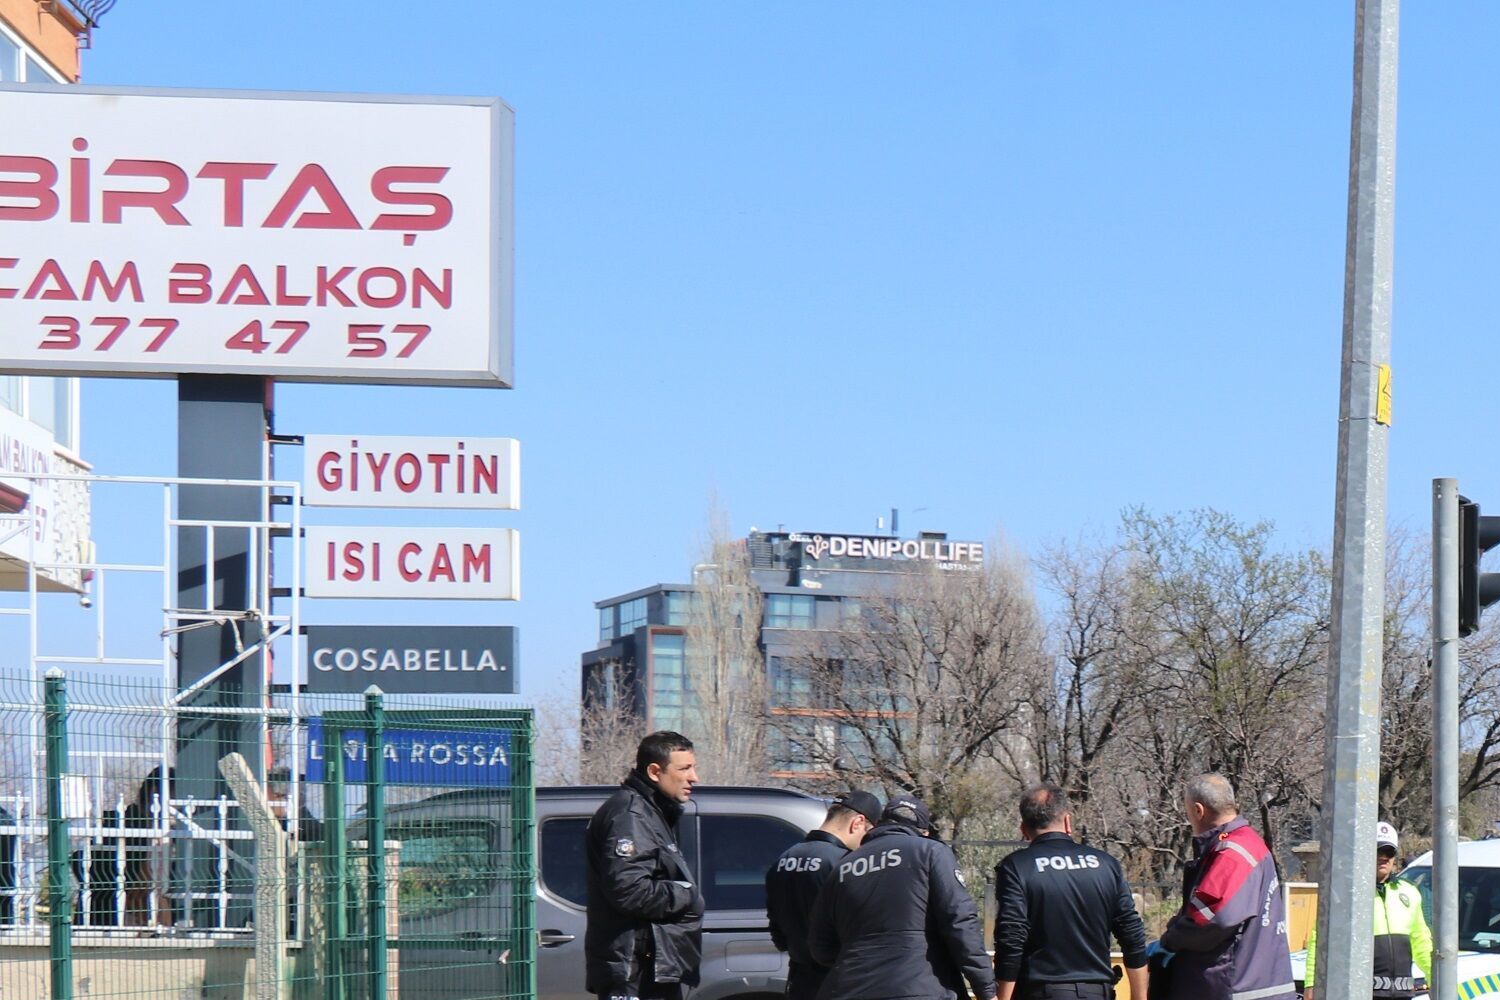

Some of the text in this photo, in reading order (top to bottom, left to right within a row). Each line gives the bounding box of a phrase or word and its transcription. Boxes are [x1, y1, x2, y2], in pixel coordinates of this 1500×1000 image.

[168, 262, 453, 309] BALKON
[38, 315, 432, 359] 377 47 57
[316, 439, 499, 495] GİYOTİN
[327, 540, 492, 583] ISI CAM
[410, 743, 508, 767] ROSSA
